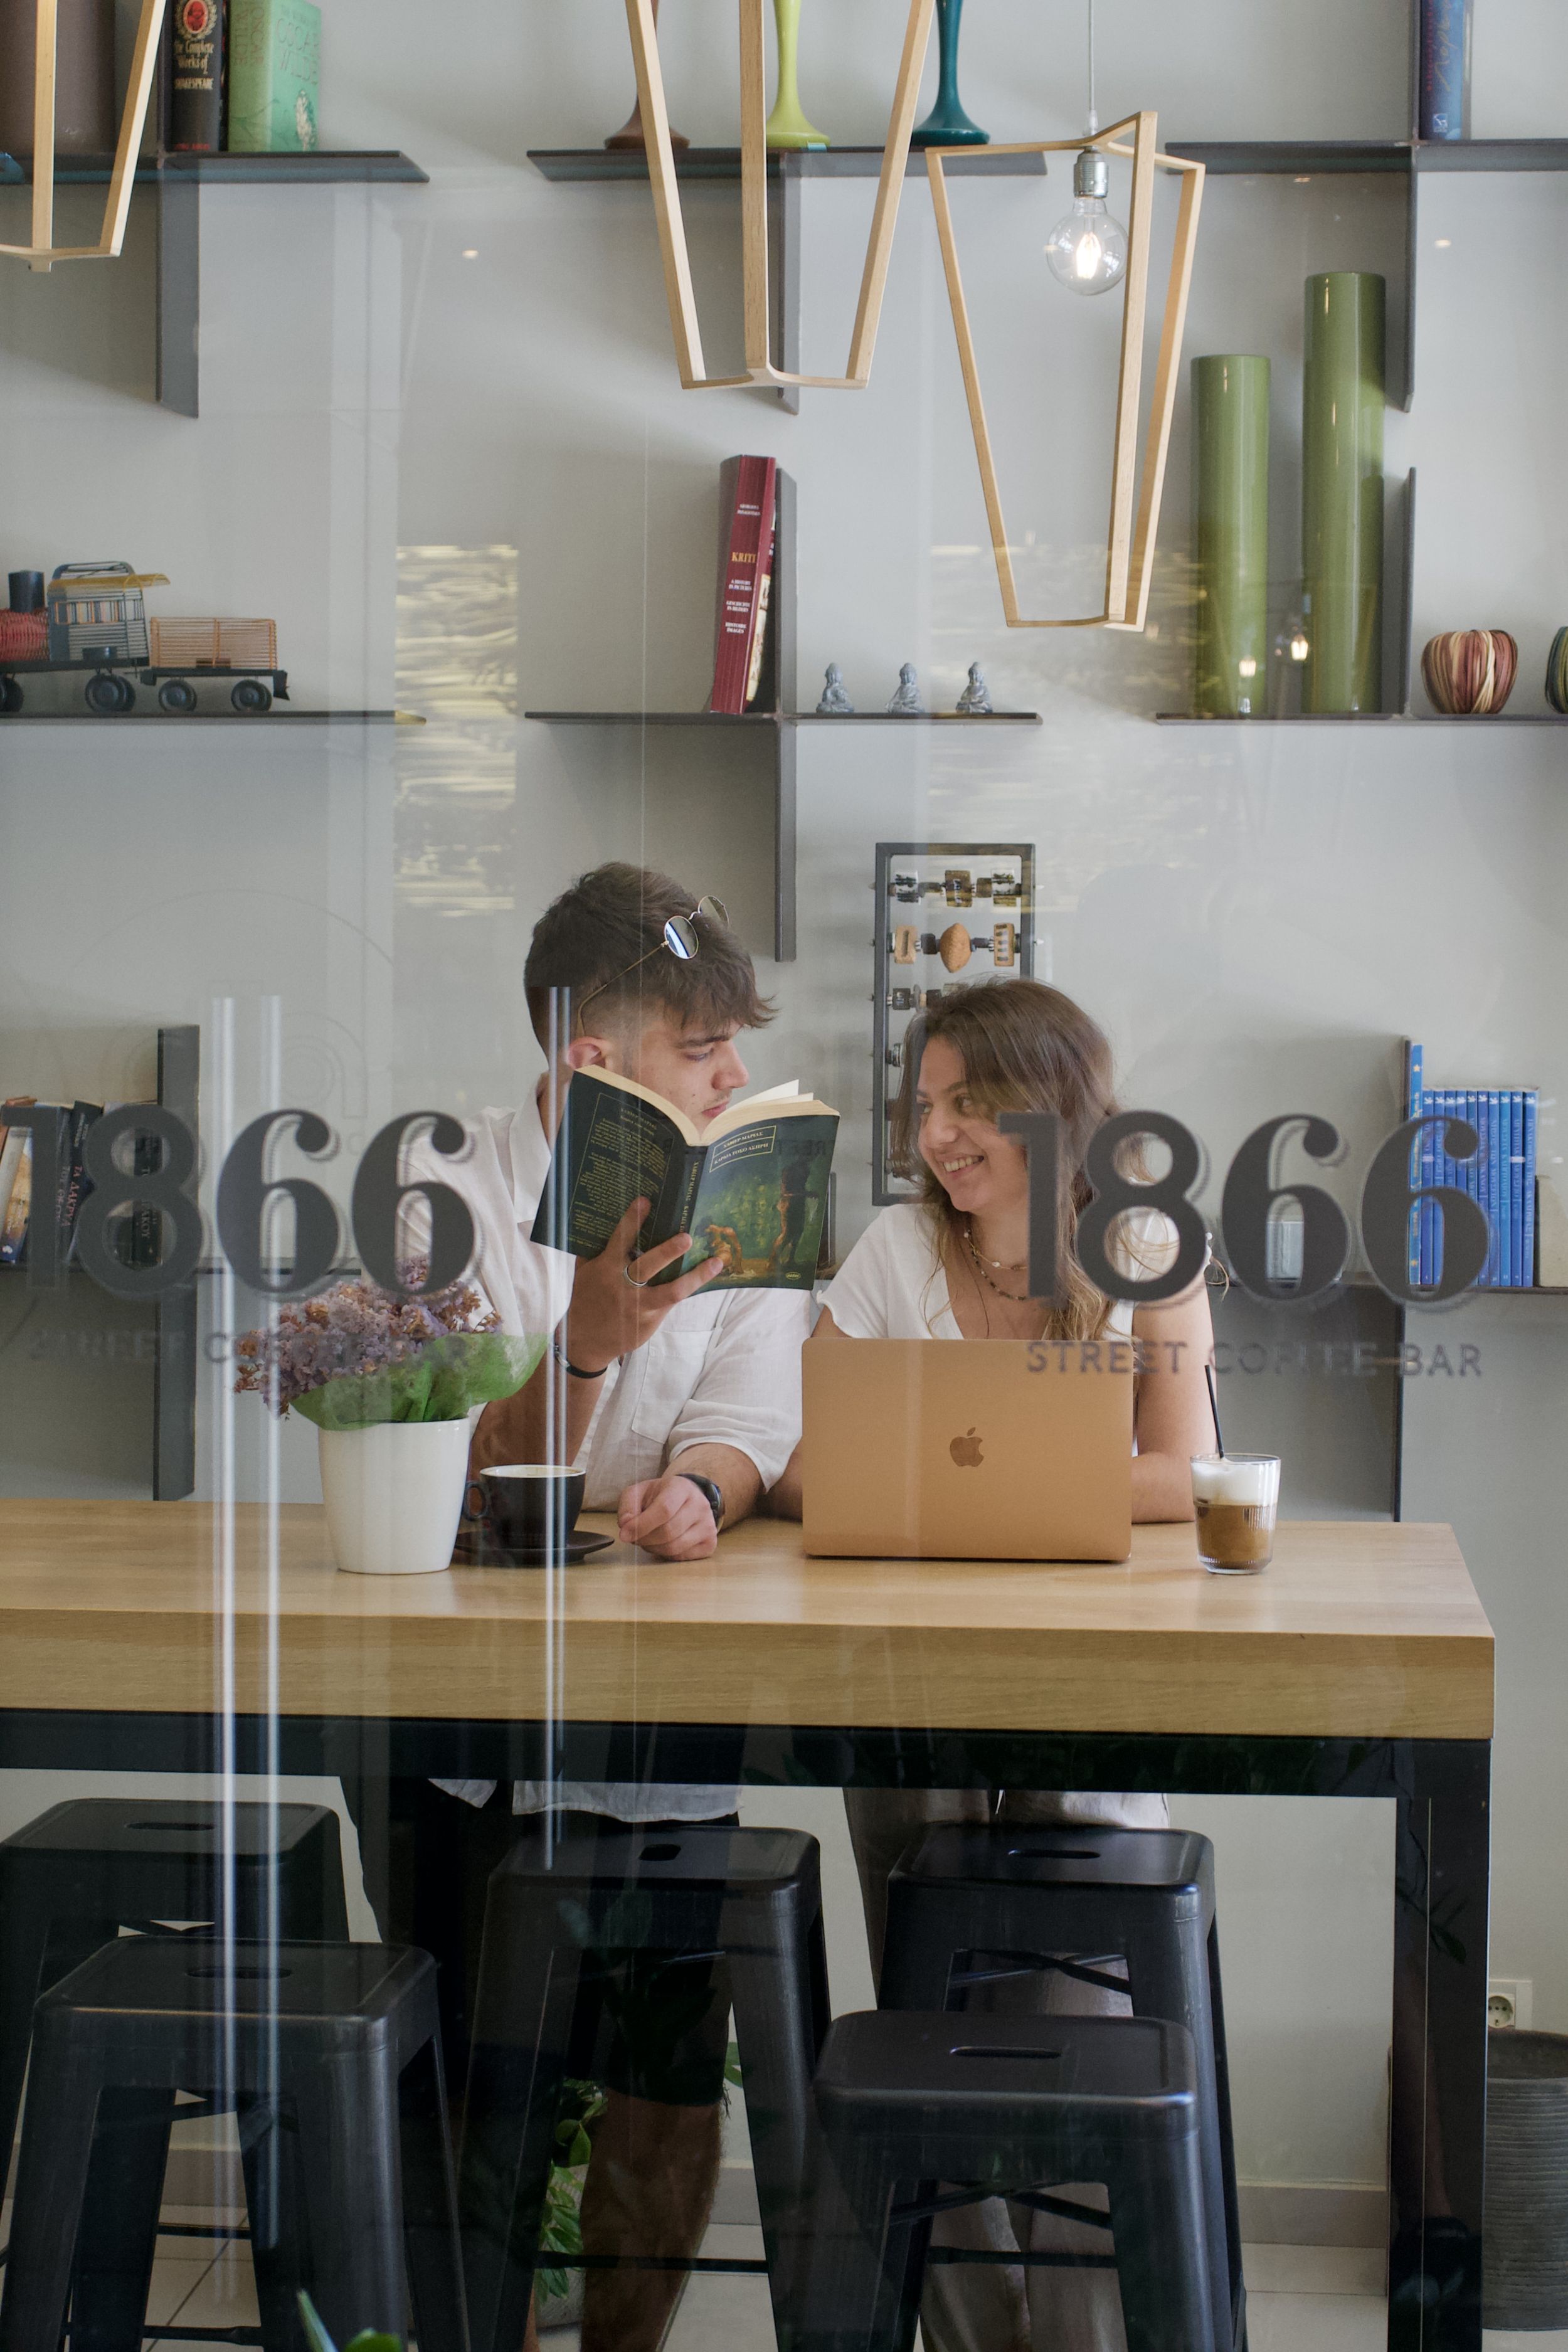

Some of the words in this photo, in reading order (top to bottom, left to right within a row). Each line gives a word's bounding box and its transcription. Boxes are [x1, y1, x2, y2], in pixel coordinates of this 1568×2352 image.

[731, 551, 756, 564] KRITI
[2, 1103, 477, 1295] 1866
[999, 1110, 1490, 1303] 1866
[1026, 1340, 1188, 1374] STREET
[1399, 1344, 1482, 1377] BAR
